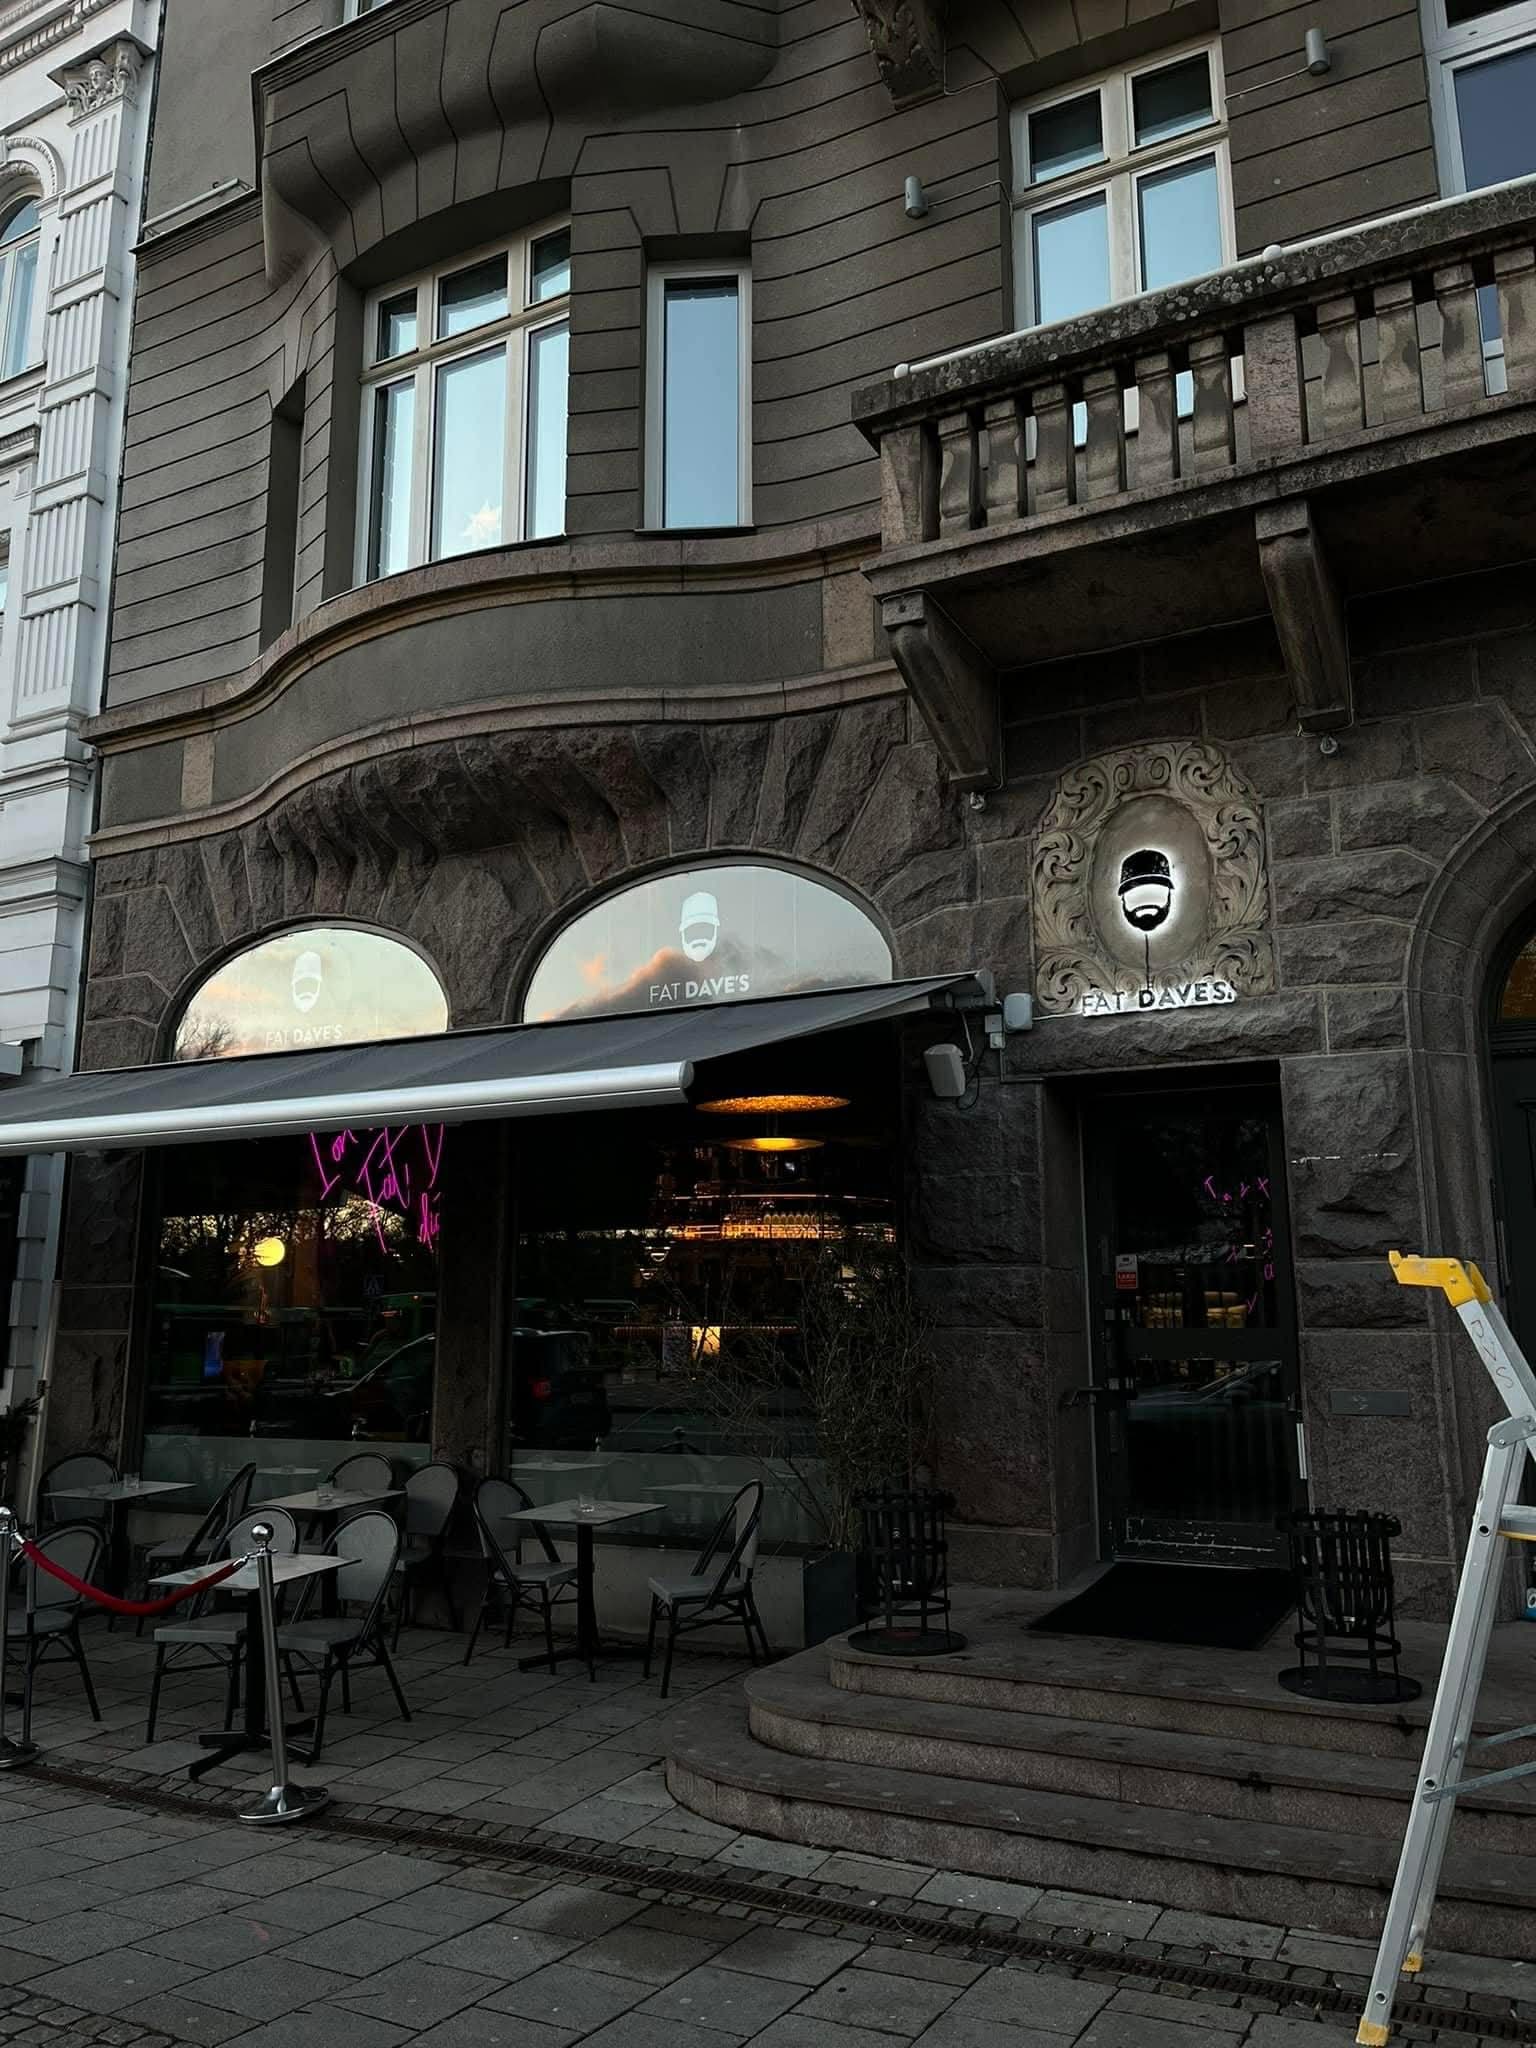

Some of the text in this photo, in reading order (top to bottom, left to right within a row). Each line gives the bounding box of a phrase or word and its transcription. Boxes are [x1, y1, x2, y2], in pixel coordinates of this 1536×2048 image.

[649, 974, 749, 1003] FAT DAVE'S
[1082, 991, 1125, 1014] FAT
[265, 1030, 289, 1048] FAT
